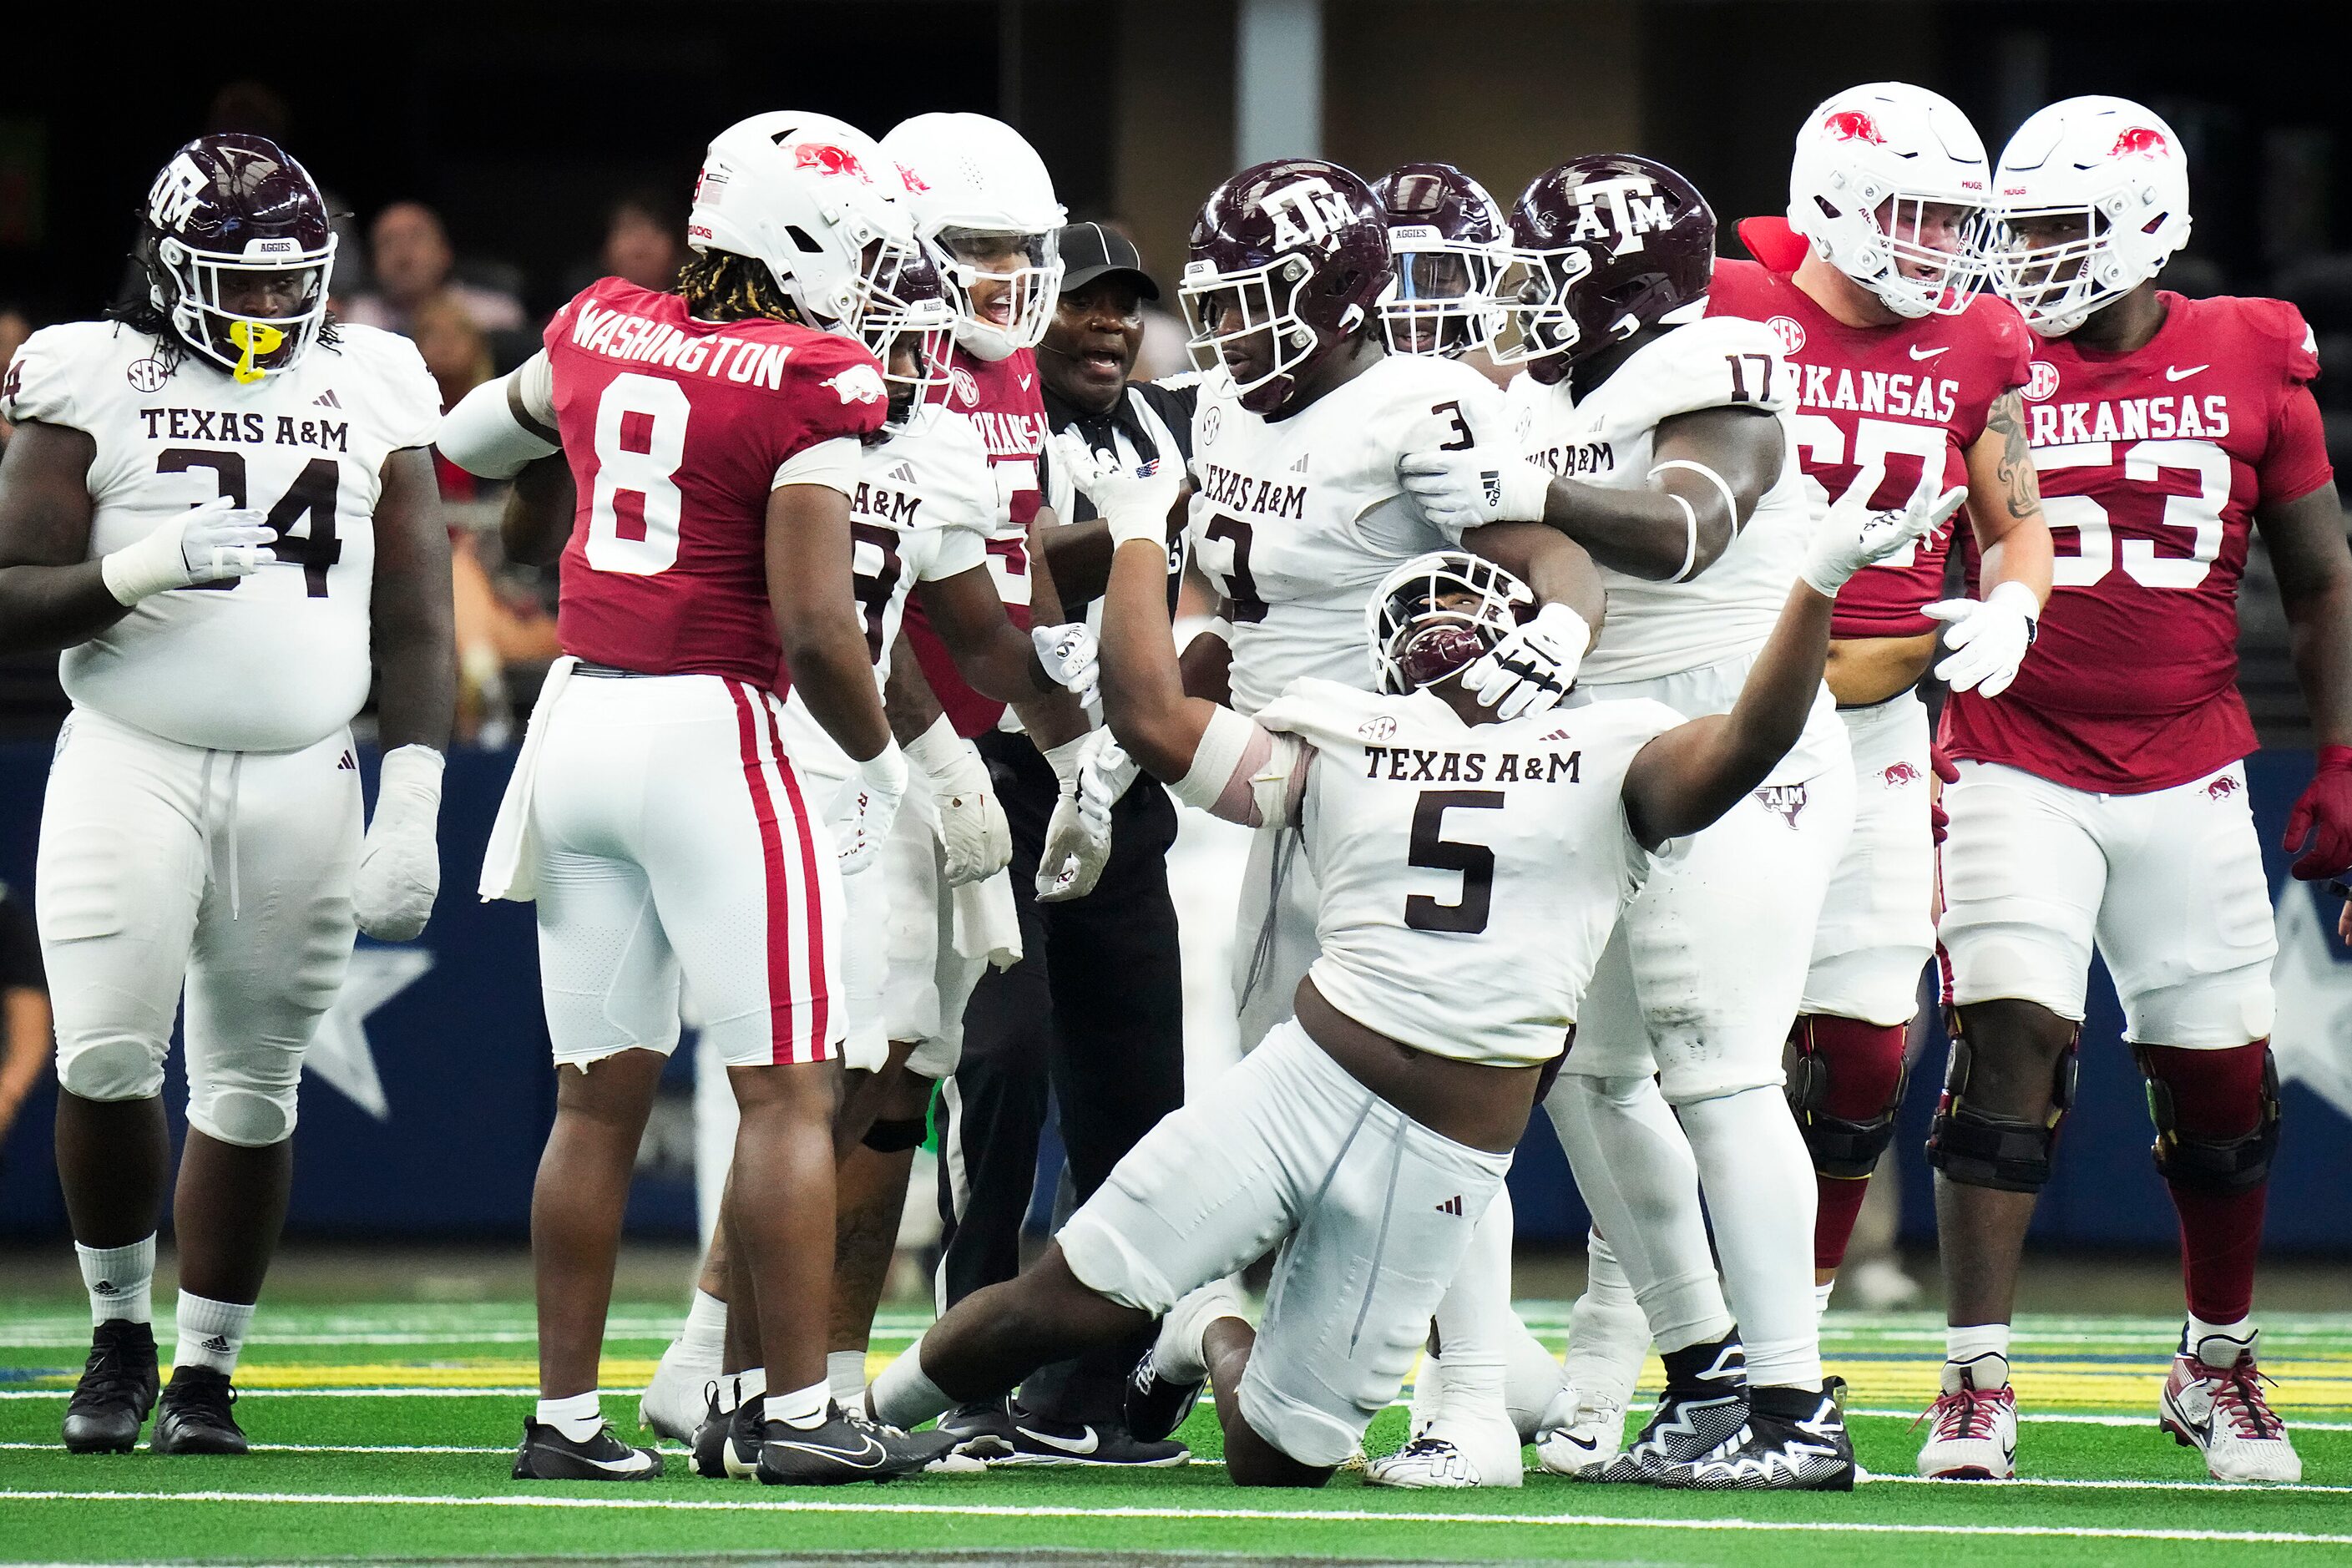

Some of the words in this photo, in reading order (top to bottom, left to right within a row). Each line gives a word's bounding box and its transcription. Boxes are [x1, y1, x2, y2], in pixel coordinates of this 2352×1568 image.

[260, 242, 291, 252] AGGIES
[1396, 230, 1427, 238] AGGIES
[572, 299, 793, 391] WASHINGTON
[1725, 353, 1772, 402] 17
[1785, 362, 1960, 422] RKANSAS
[139, 407, 265, 444] TEXAS
[276, 415, 349, 453] A&M
[1431, 400, 1474, 451] 3
[2027, 395, 2230, 448] RKANSAS
[584, 372, 692, 576] 8
[1562, 442, 1614, 477] A&M
[852, 482, 923, 529] A&M
[1204, 463, 1252, 513] EXAS
[1252, 480, 1308, 520] A&M
[2029, 439, 2233, 589] 53
[1364, 746, 1487, 782] TEXAS
[1495, 751, 1582, 784] A&M
[1404, 789, 1505, 935] 5
